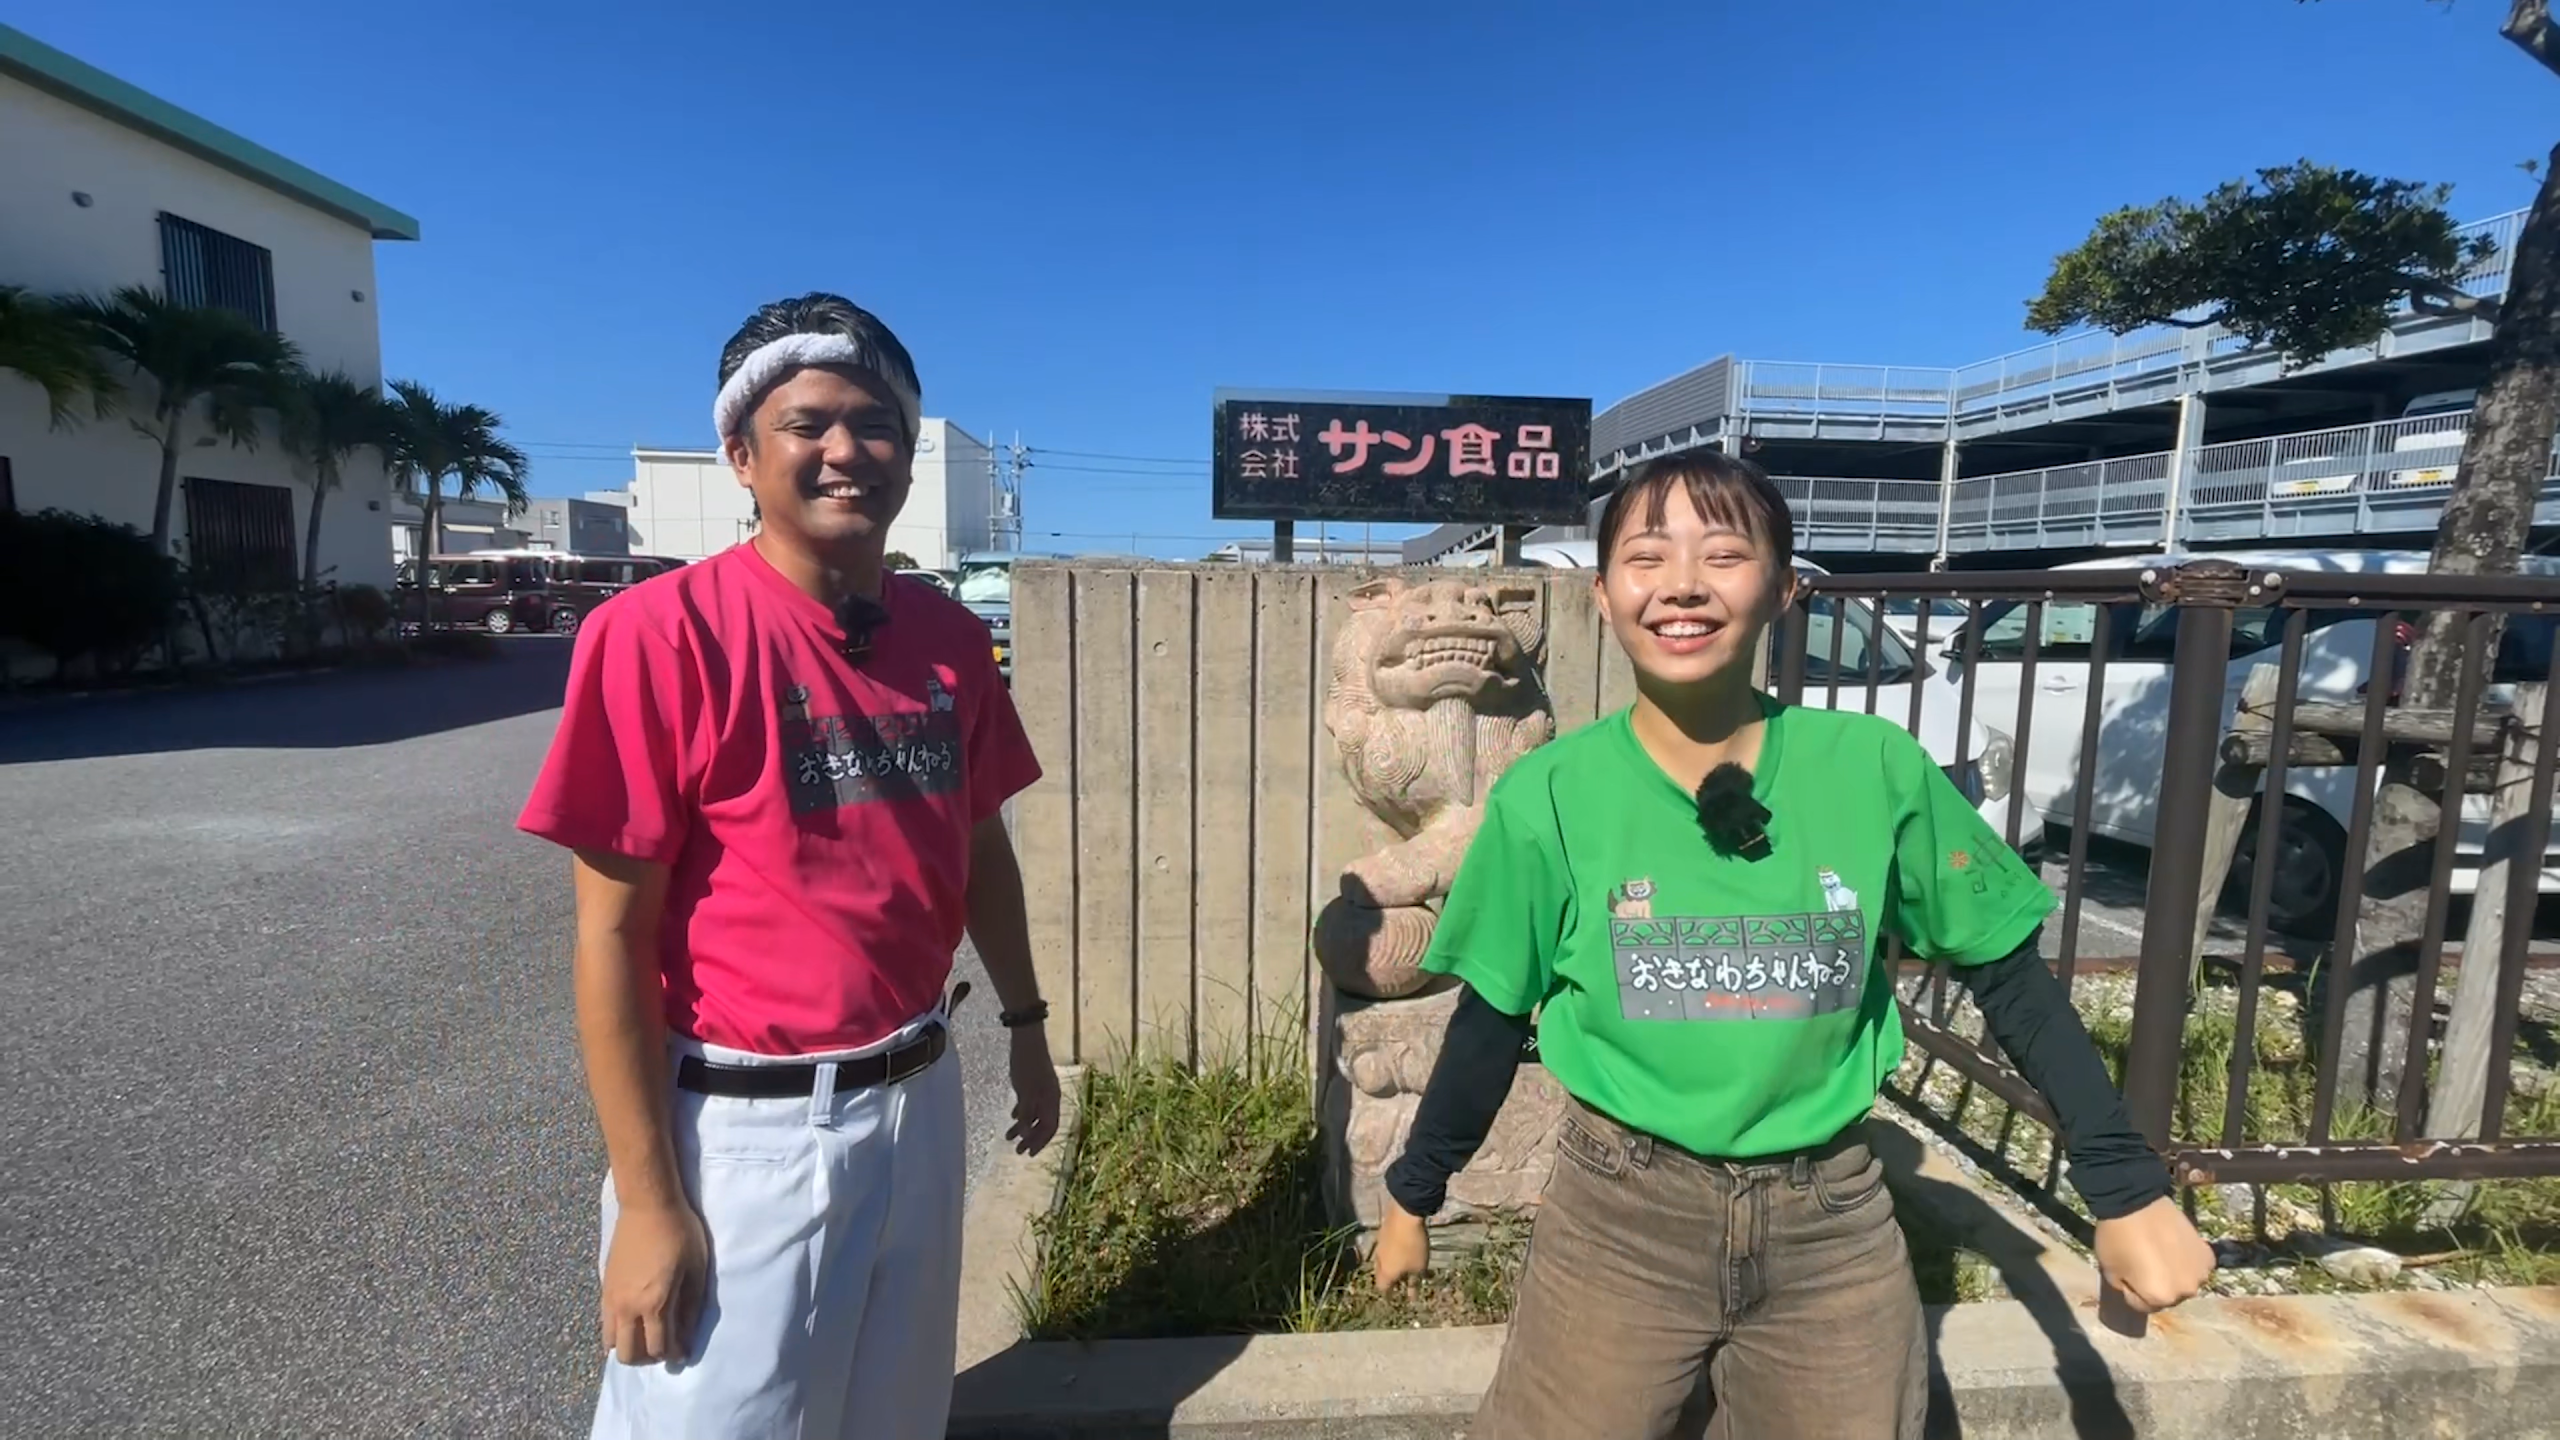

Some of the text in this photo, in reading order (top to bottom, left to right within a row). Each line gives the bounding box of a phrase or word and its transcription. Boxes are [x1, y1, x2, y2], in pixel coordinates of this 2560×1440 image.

[1239, 412, 1300, 442] 株式
[1239, 448, 1300, 480] 会社
[1317, 419, 1560, 480] サン食品
[1631, 948, 1851, 992] おきなわちゃんねる
